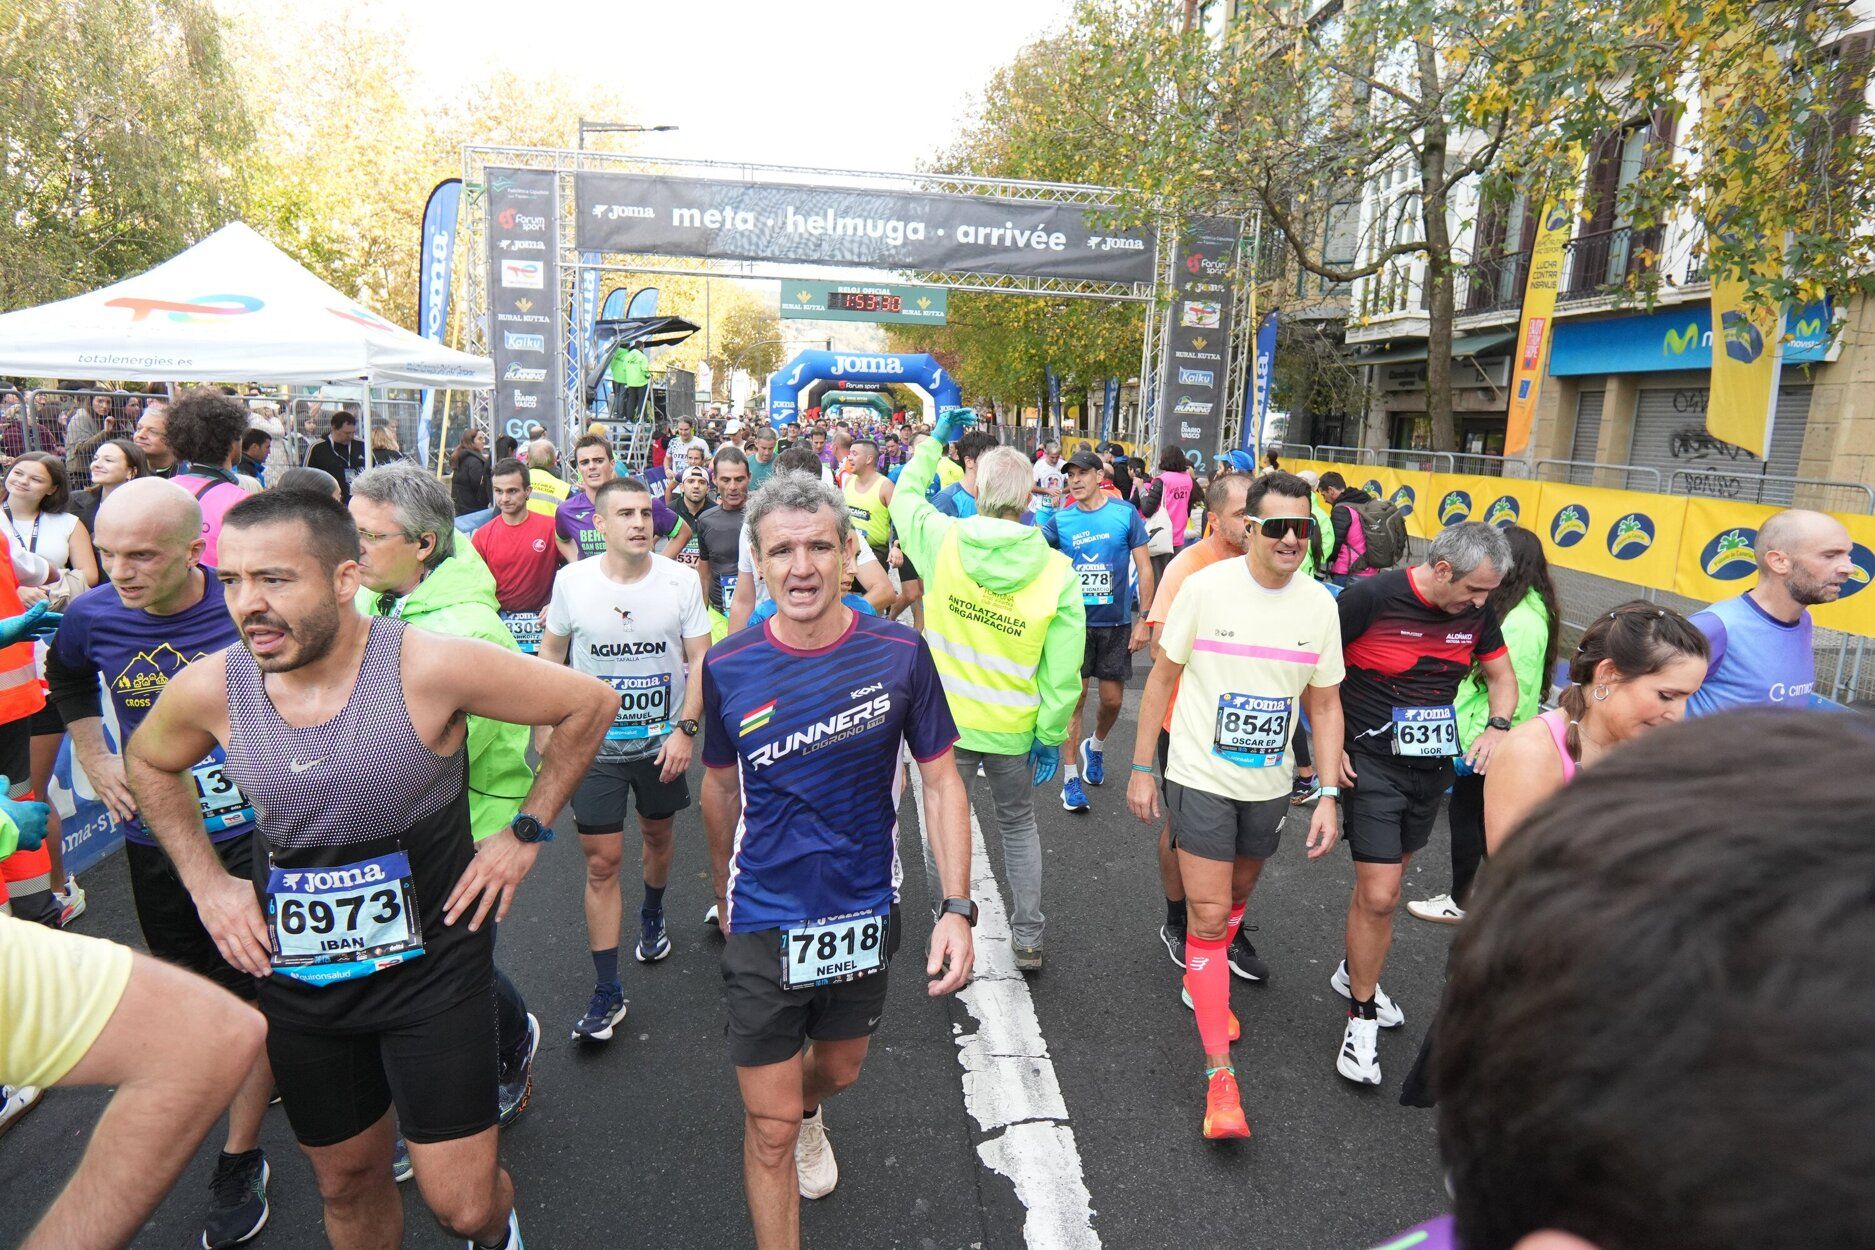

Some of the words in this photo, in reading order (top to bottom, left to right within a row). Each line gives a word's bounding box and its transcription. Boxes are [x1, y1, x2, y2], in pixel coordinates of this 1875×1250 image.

[516, 214, 544, 224] Forum
[523, 223, 546, 232] sport
[673, 206, 754, 230] meta
[786, 206, 924, 246] helmuga
[956, 222, 1066, 250] arrivée
[1532, 270, 1558, 280] CONTRA
[862, 287, 890, 295] OFICIAL
[1195, 282, 1225, 292] Jma
[844, 294, 902, 312] 1:53:30
[498, 314, 522, 322] RURAL
[524, 314, 550, 322] KUTXA
[508, 334, 540, 348] Kaiku
[1198, 352, 1221, 360] KUTXA
[830, 356, 903, 375] Joma
[1182, 372, 1210, 383] Kaiku
[580, 530, 605, 542] BEH
[1072, 530, 1090, 540] SALTO
[1072, 532, 1110, 547] FOUNDATION
[678, 554, 700, 564] 537
[1080, 574, 1108, 585] 278
[948, 594, 1026, 629] ANTOLATZAILEA
[949, 604, 1022, 637] ORGANIZACIÓN
[591, 642, 666, 656] AGUAZON
[621, 676, 660, 689] Joma
[620, 690, 663, 710] 000
[1245, 698, 1285, 710] Joma
[617, 712, 652, 720] SAMUEL
[1416, 708, 1451, 721] Joma
[1224, 712, 1284, 736] 8543
[748, 693, 890, 771] RUNNERS
[1400, 724, 1454, 744] 6319
[803, 724, 864, 756] LOGROÑO
[1232, 737, 1264, 746] OSCAR
[304, 864, 385, 892] Joma
[281, 889, 401, 934] 6973
[321, 937, 365, 951] IBAN
[792, 923, 879, 964] 7818
[817, 960, 857, 976] NENEL
